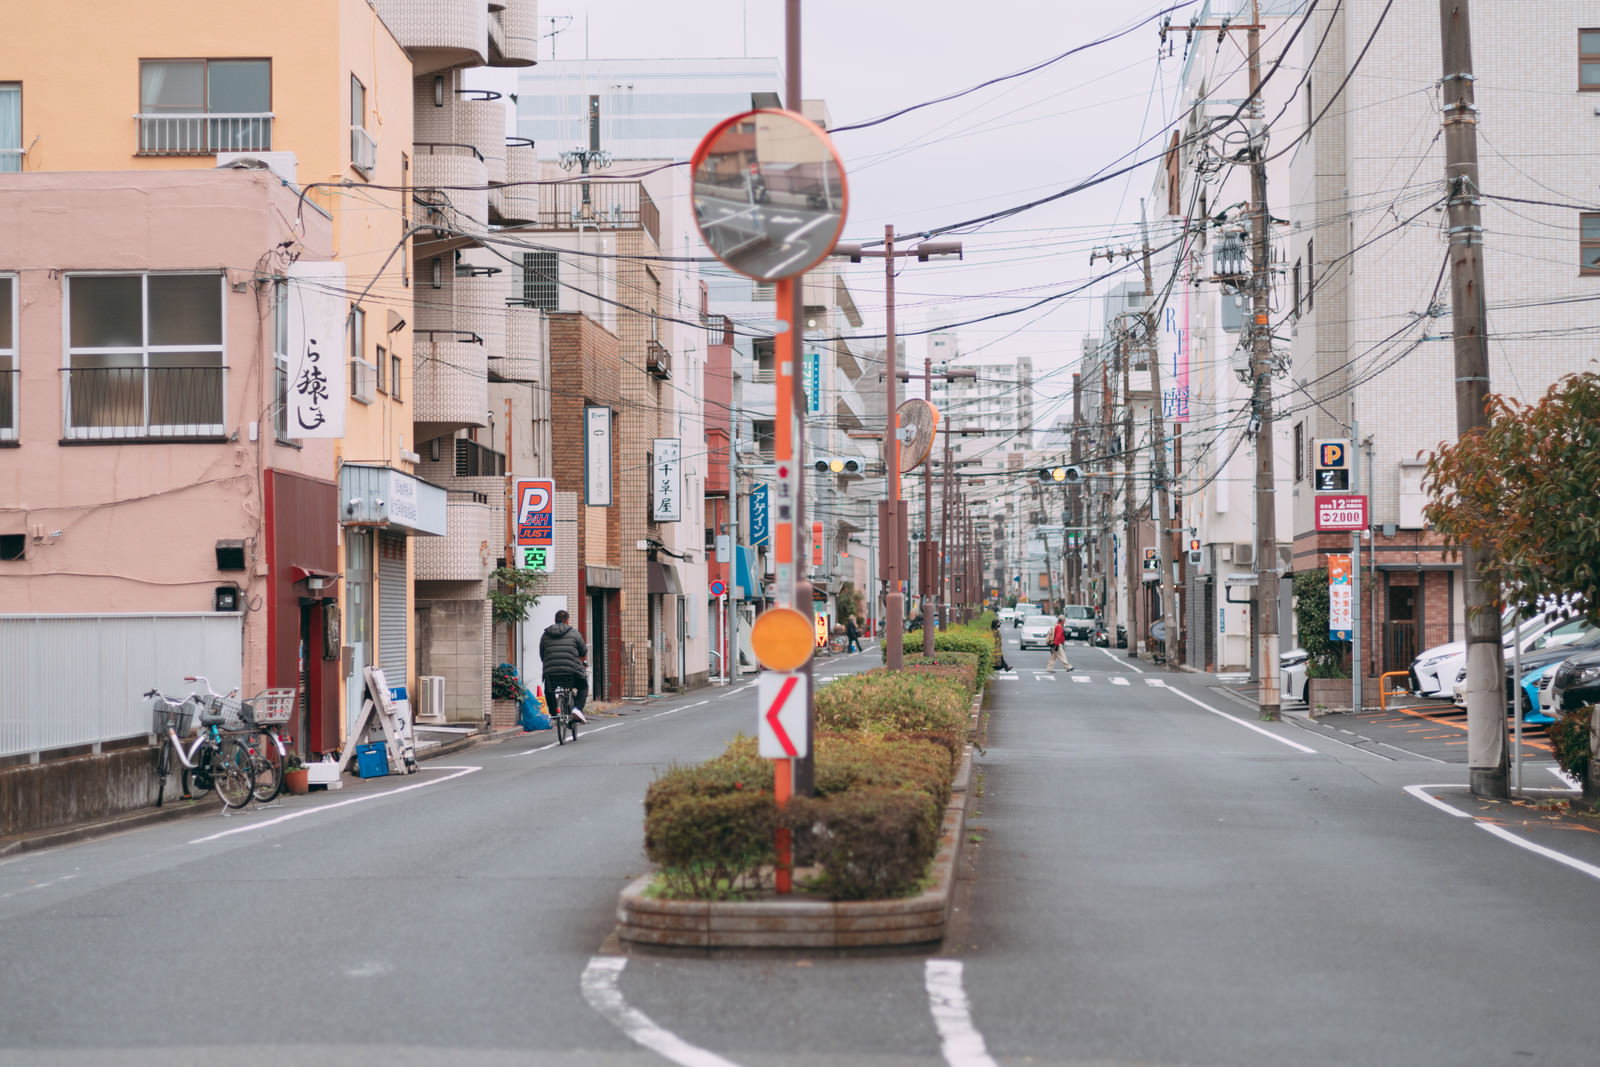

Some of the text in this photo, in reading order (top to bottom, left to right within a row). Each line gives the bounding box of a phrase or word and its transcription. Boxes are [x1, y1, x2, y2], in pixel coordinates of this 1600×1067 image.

[1324, 445, 1341, 465] P
[657, 464, 673, 513] 千草屋
[519, 488, 549, 524] P
[752, 491, 766, 538] アゲイン
[1332, 499, 1346, 509] 12
[524, 513, 548, 526] 24H
[520, 529, 551, 538] JUST
[524, 547, 546, 570] 空
